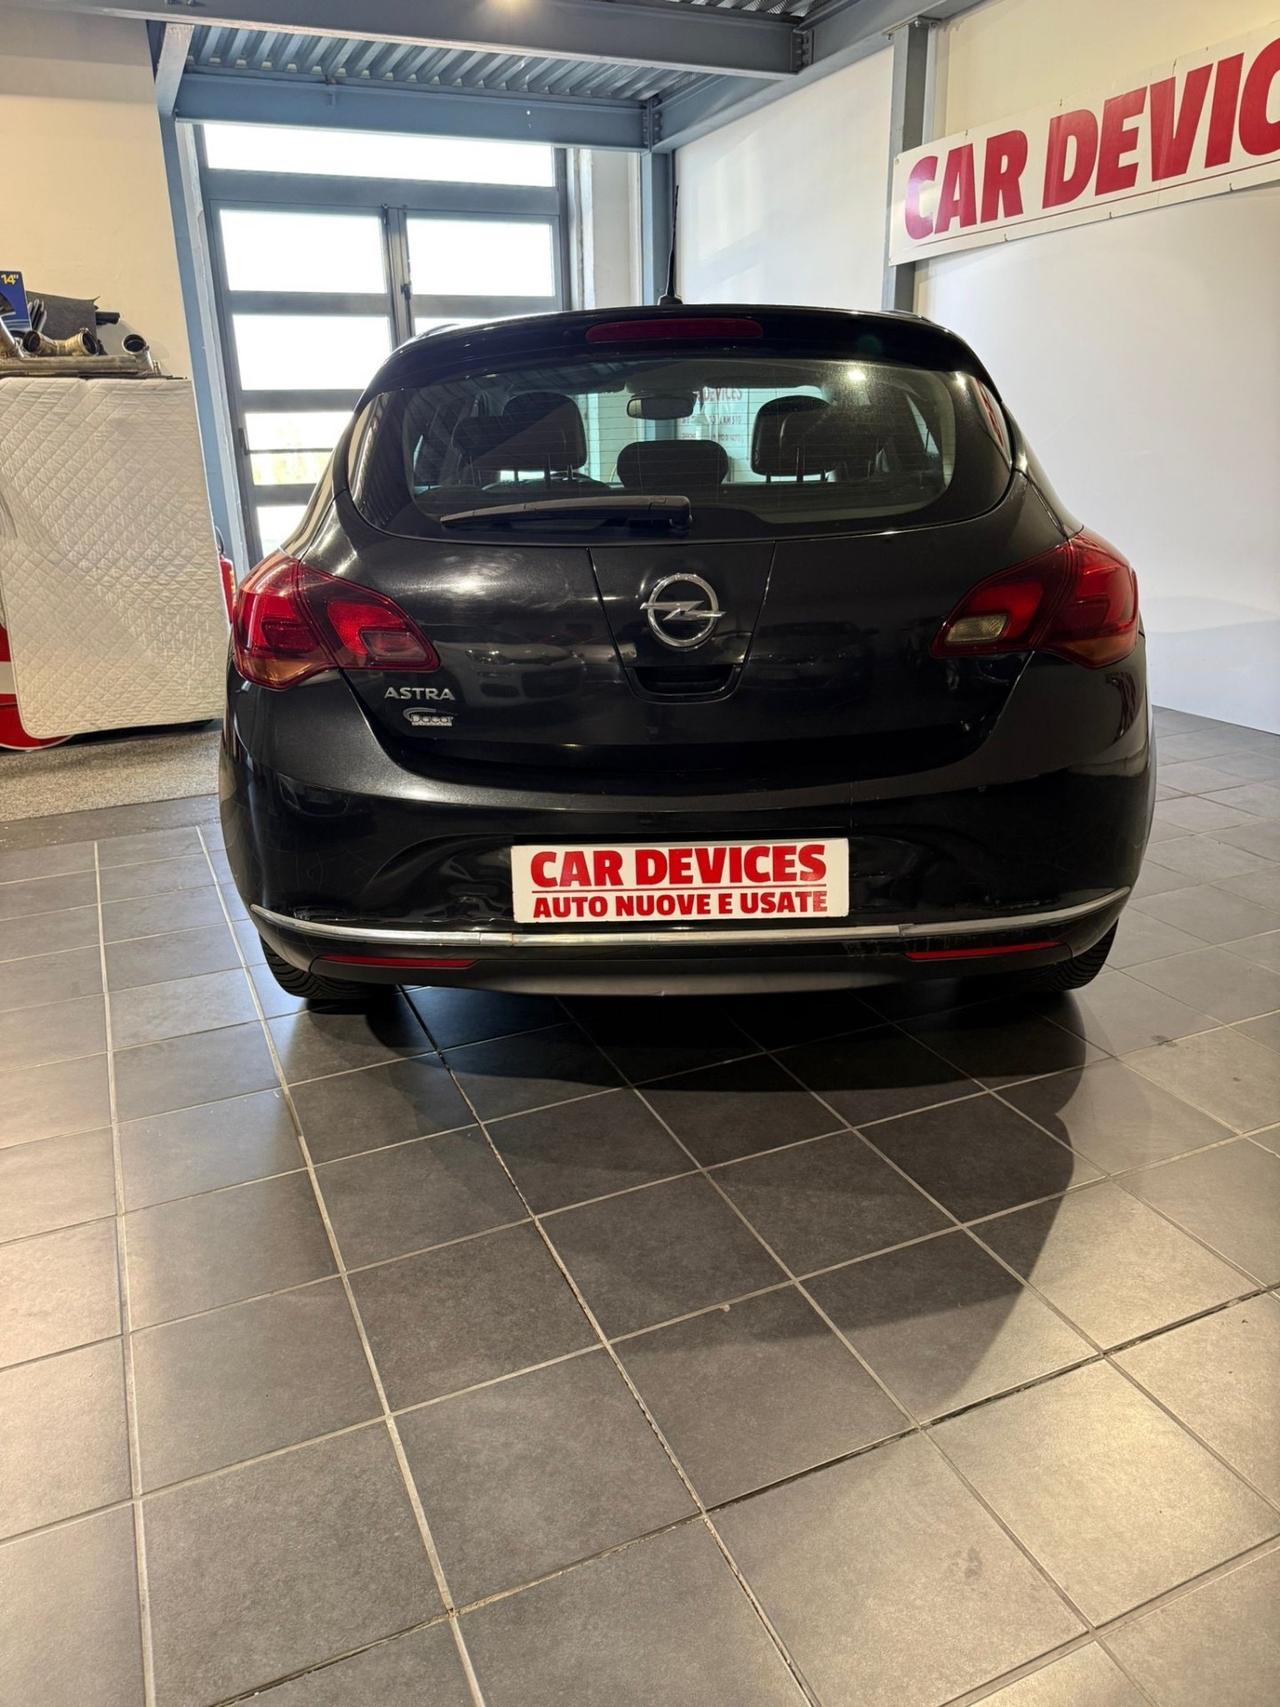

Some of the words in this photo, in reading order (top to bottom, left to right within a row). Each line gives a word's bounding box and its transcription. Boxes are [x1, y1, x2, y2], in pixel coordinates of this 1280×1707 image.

[904, 129, 1029, 240] CAR
[1042, 37, 1280, 209] DEVIC
[384, 686, 456, 700] ASTRA
[530, 850, 623, 888] CAR
[635, 844, 827, 886] DEVICES
[533, 895, 609, 918] AUTO
[615, 893, 711, 917] NUOVE
[718, 892, 733, 914] E
[740, 890, 828, 914] USATE
